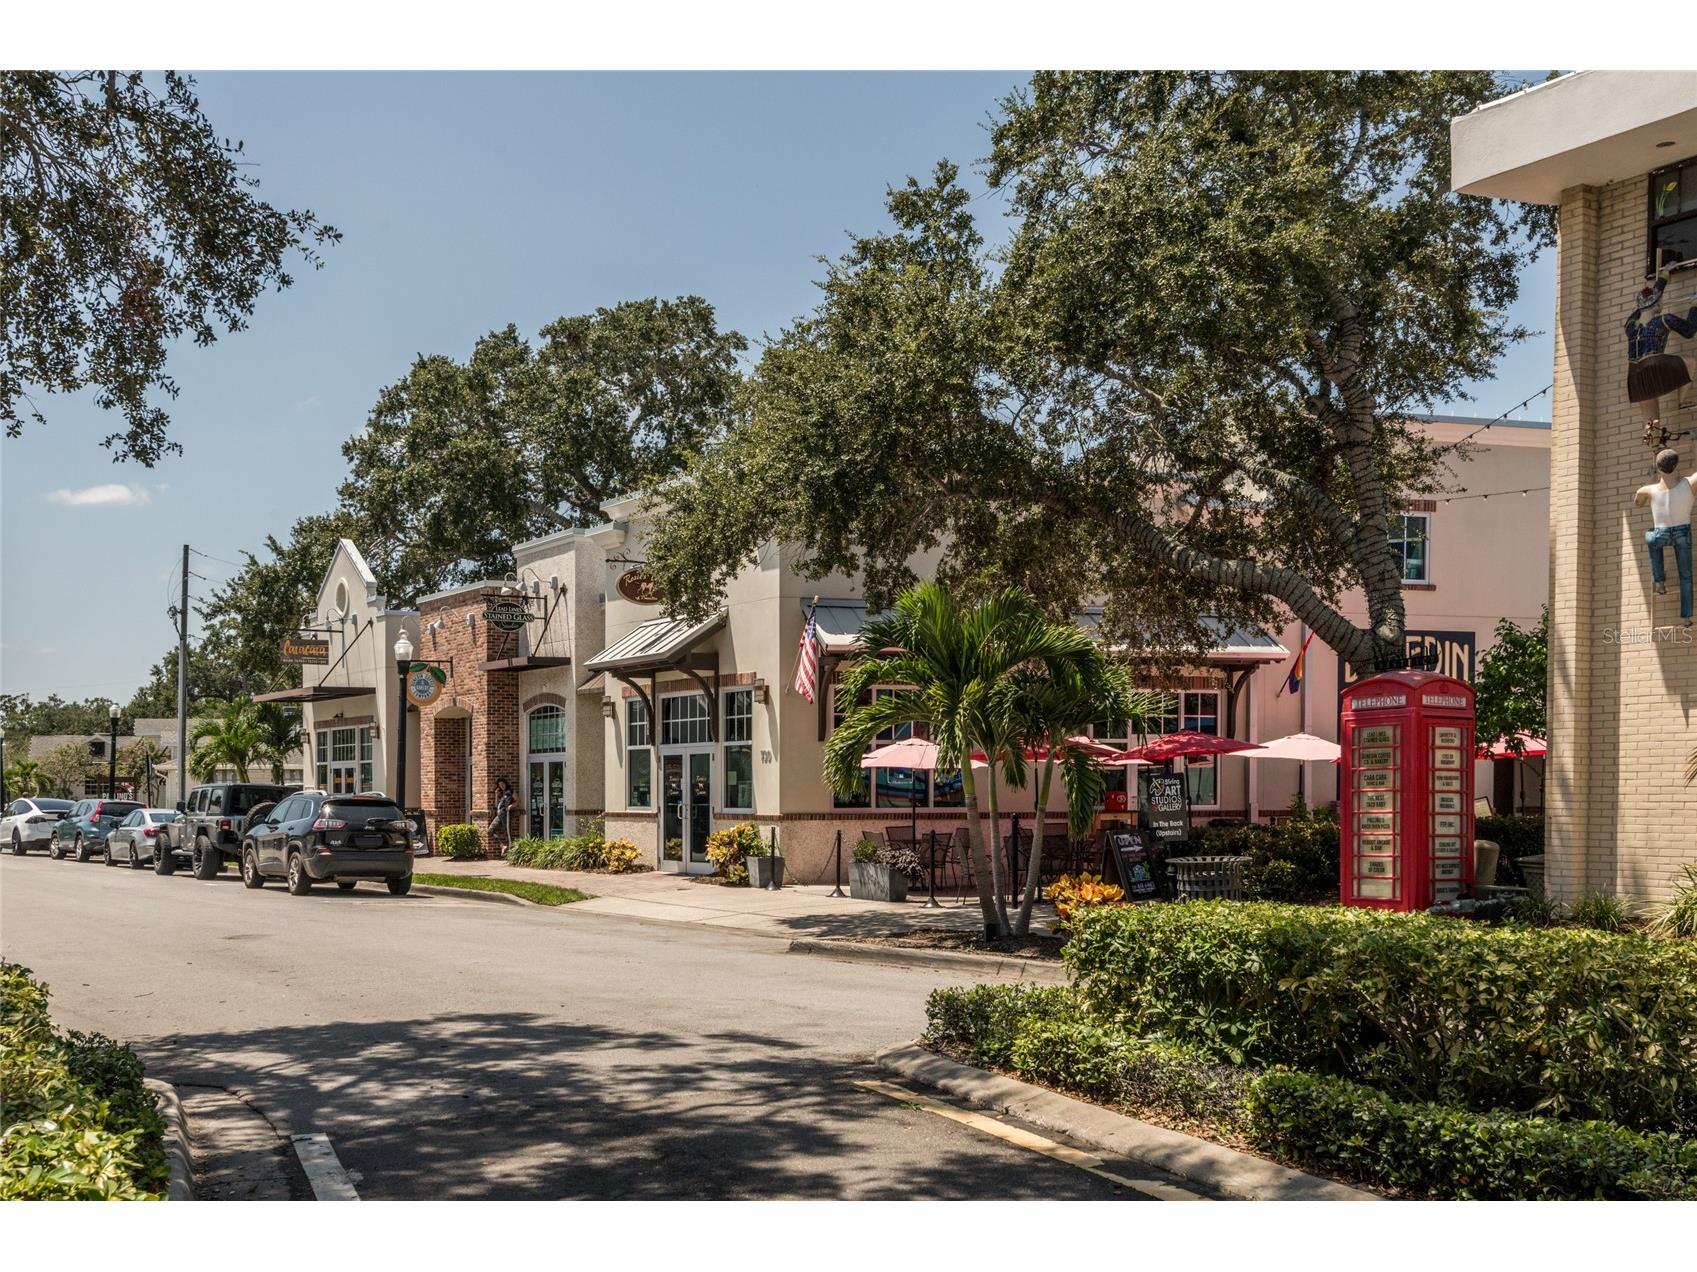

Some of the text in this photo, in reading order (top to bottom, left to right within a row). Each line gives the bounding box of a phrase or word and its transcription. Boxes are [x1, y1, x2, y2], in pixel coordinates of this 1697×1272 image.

[484, 612, 534, 621] STAINED GLASS
[1358, 696, 1404, 708] TELEPHONE
[1425, 696, 1465, 706] TELEPHONE
[1164, 785, 1181, 796] ART
[1151, 795, 1182, 805] STUDIOS
[1158, 802, 1182, 811] GALLERY
[1155, 829, 1182, 837] (Upstairs)
[1118, 835, 1142, 846] OPEN
